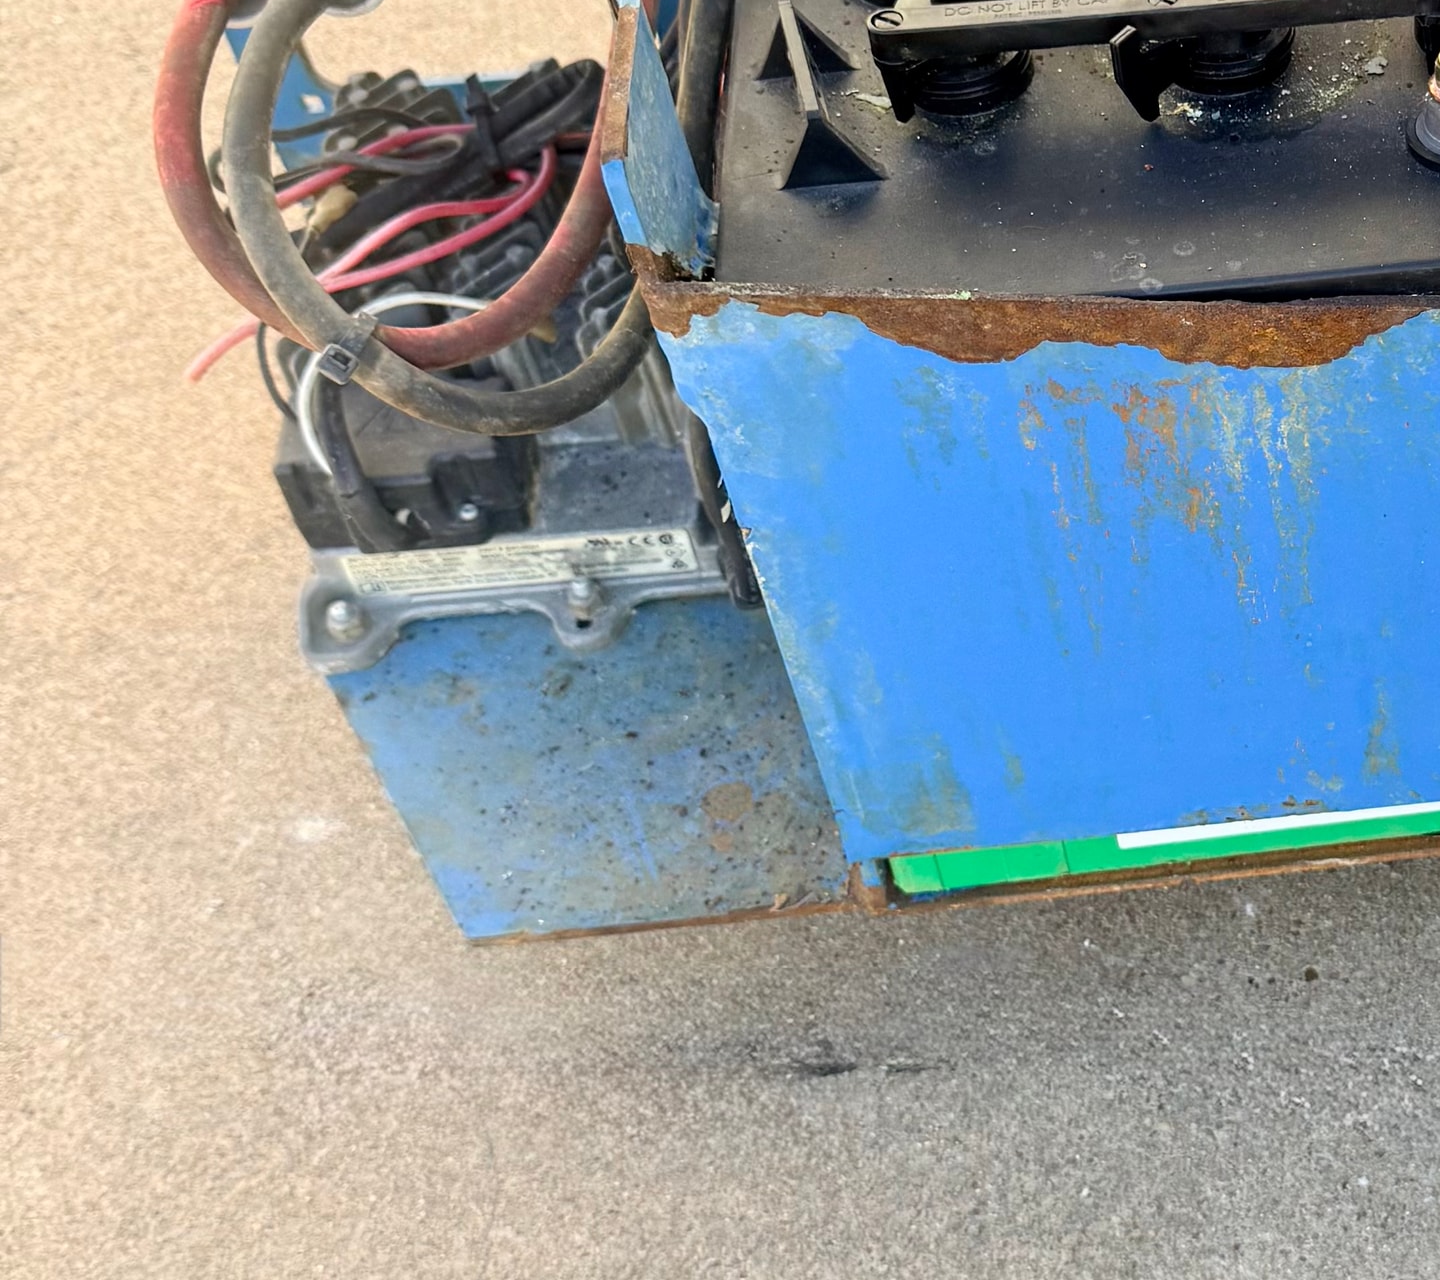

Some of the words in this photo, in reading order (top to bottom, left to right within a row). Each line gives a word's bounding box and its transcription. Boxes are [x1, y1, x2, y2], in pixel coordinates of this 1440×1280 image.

[944, 5, 973, 17] DO
[977, 2, 1014, 14] NOT
[1018, 0, 1048, 11] LIFT
